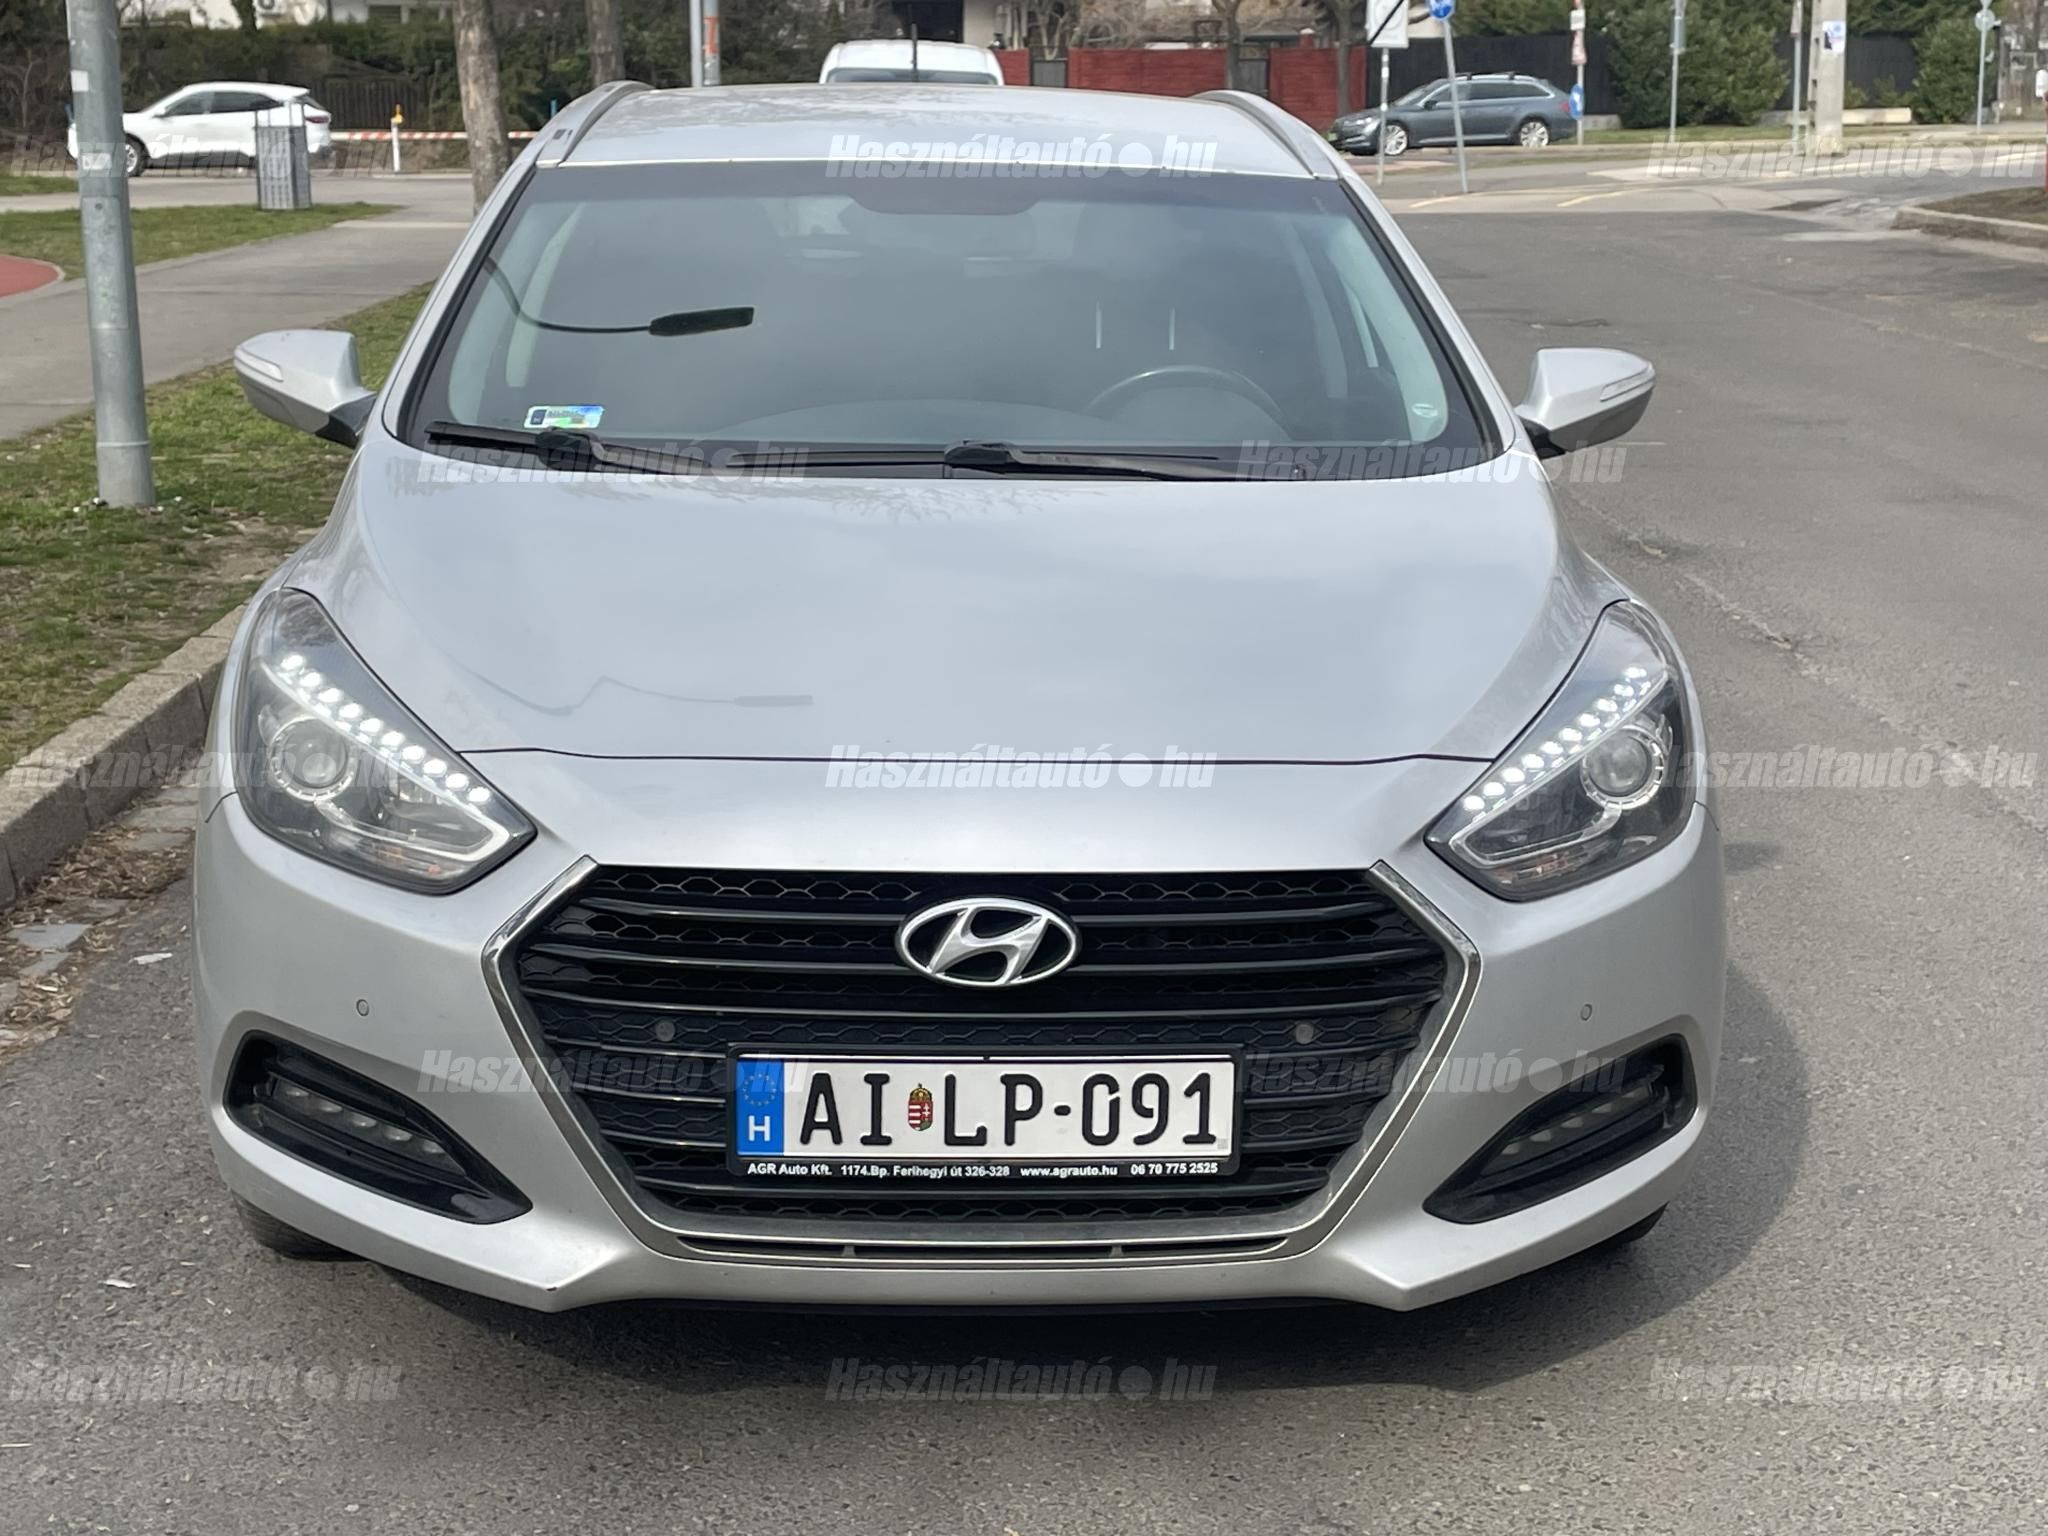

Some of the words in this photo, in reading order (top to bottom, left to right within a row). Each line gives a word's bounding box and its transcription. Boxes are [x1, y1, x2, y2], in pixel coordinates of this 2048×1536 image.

[747, 1115, 771, 1142] H
[747, 1163, 777, 1175] AGR
[778, 1164, 808, 1175] Auto
[811, 1164, 832, 1175] Kft.
[893, 1165, 948, 1178] Ferihegyi
[950, 1165, 963, 1177] út
[964, 1166, 1010, 1177] 326-328
[1020, 1165, 1118, 1178] www.agrauto.hu
[1130, 1164, 1146, 1175] 06
[1148, 1163, 1162, 1175] 70
[1165, 1163, 1187, 1174] 775
[1189, 1162, 1219, 1174] 2525
